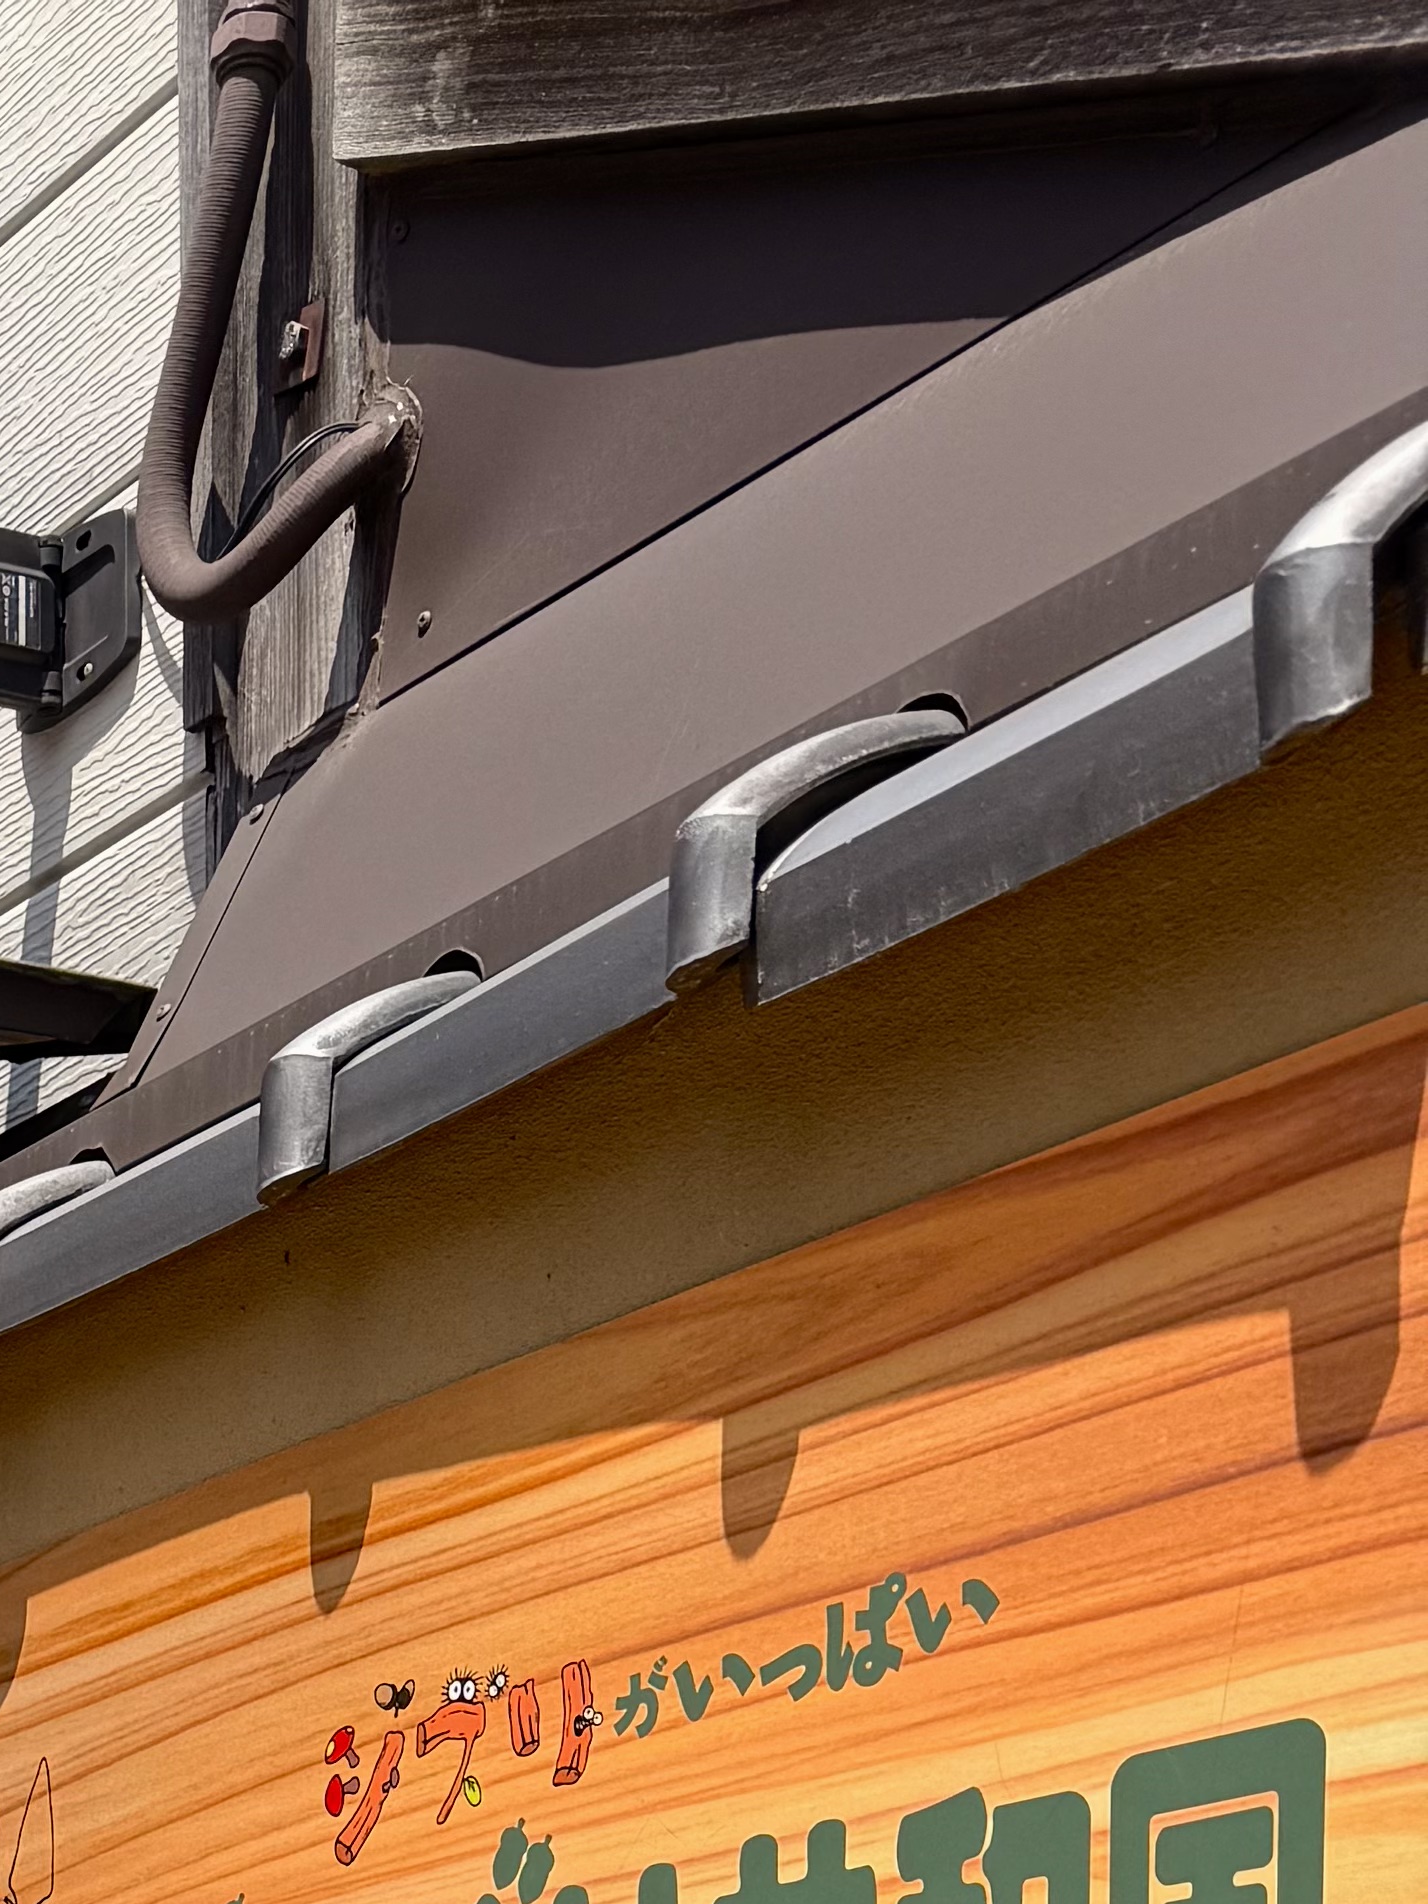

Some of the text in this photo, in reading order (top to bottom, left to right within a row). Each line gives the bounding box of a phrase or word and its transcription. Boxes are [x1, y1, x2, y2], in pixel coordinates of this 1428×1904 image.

[324, 1571, 1001, 1867] ジブリがいっぱい
